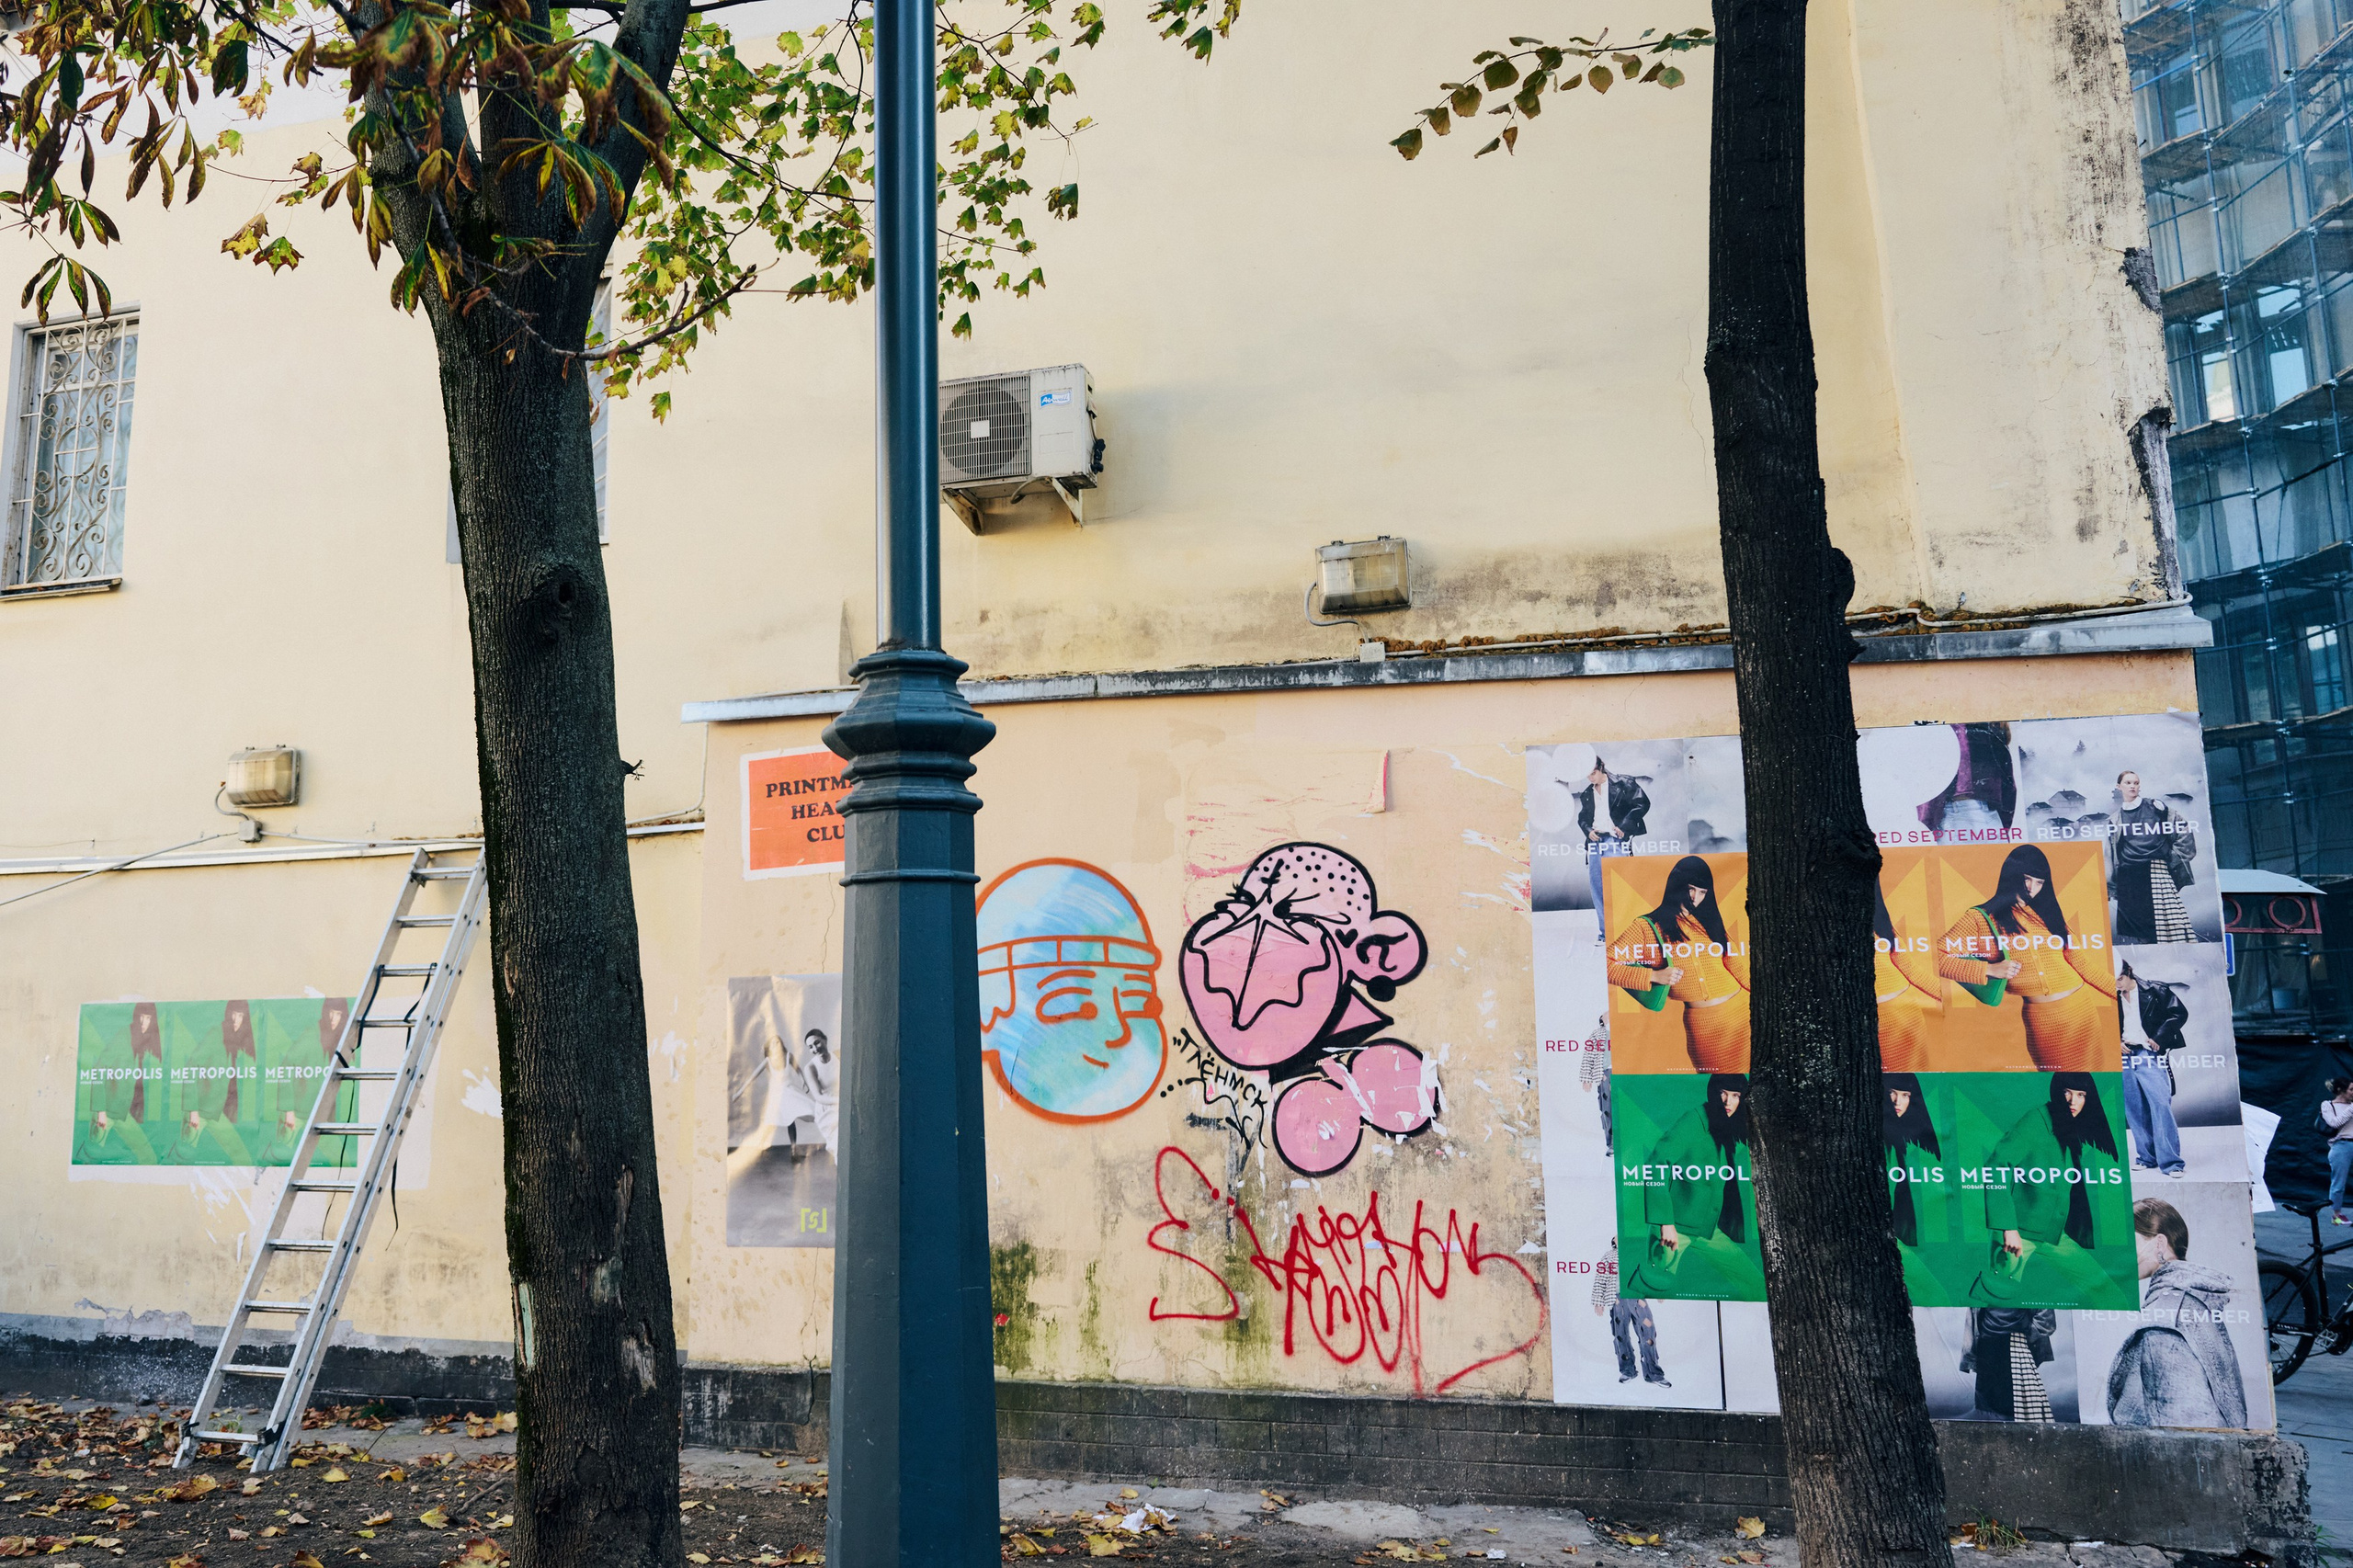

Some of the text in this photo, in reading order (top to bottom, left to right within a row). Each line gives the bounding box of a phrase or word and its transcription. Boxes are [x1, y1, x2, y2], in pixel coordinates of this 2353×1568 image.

[807, 824, 845, 843] CLU
[1907, 827, 2023, 843] SEPTEMBER
[2037, 819, 2200, 840] RED SEPTEMBER
[1538, 840, 1681, 857] RED SEPTEMBER
[1874, 936, 1929, 953] OLIS
[1945, 933, 2105, 951] METROPOLIS
[1613, 941, 1745, 960] METROPOLI
[1545, 1040, 1610, 1052] RED SE
[2121, 1054, 2225, 1069] EPTEMBER
[79, 1067, 163, 1081] METROPOLIS
[170, 1066, 257, 1079] METROPOLIS
[1622, 1165, 1750, 1181] METROPOL
[1889, 1166, 1945, 1183] OLIS
[1961, 1166, 2123, 1184] METROPOLIS
[1556, 1261, 1618, 1275] RED SE
[2082, 1309, 2251, 1324] RED SEPTEMBER
